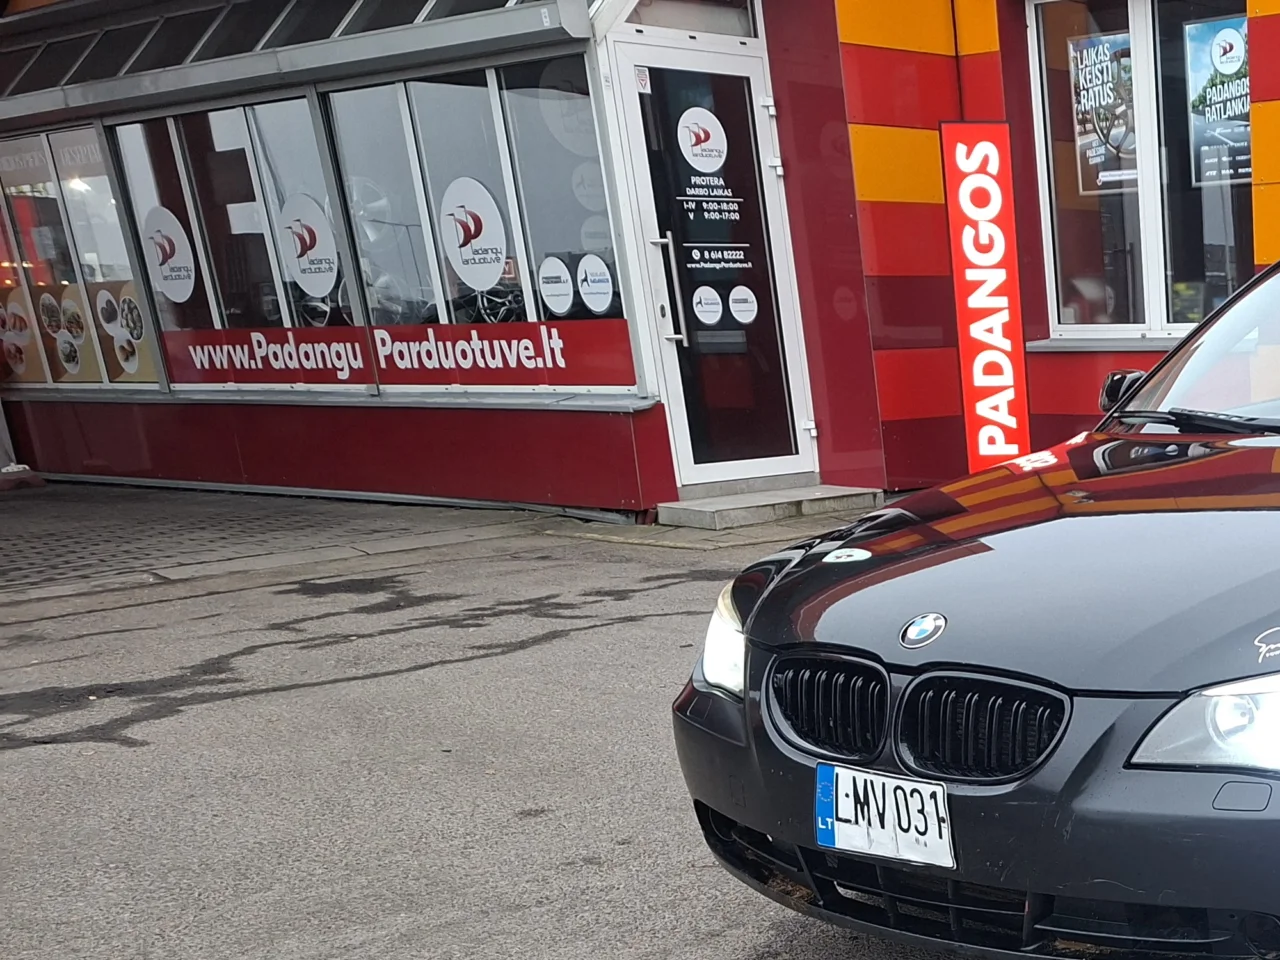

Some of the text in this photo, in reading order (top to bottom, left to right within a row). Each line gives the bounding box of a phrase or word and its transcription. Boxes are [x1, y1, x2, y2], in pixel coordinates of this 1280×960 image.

[1077, 43, 1110, 69] LAIKAS
[1079, 61, 1113, 90] KEISTI
[1080, 82, 1114, 112] RATUS
[686, 187, 732, 196] DARBO LAIKAS
[691, 176, 725, 186] PROTERA
[688, 211, 740, 220] V 9:00-17:00
[955, 141, 1019, 456] PADANGOS
[189, 325, 566, 380] www.Padangu Parduotuve.lt
[818, 816, 833, 829] LT
